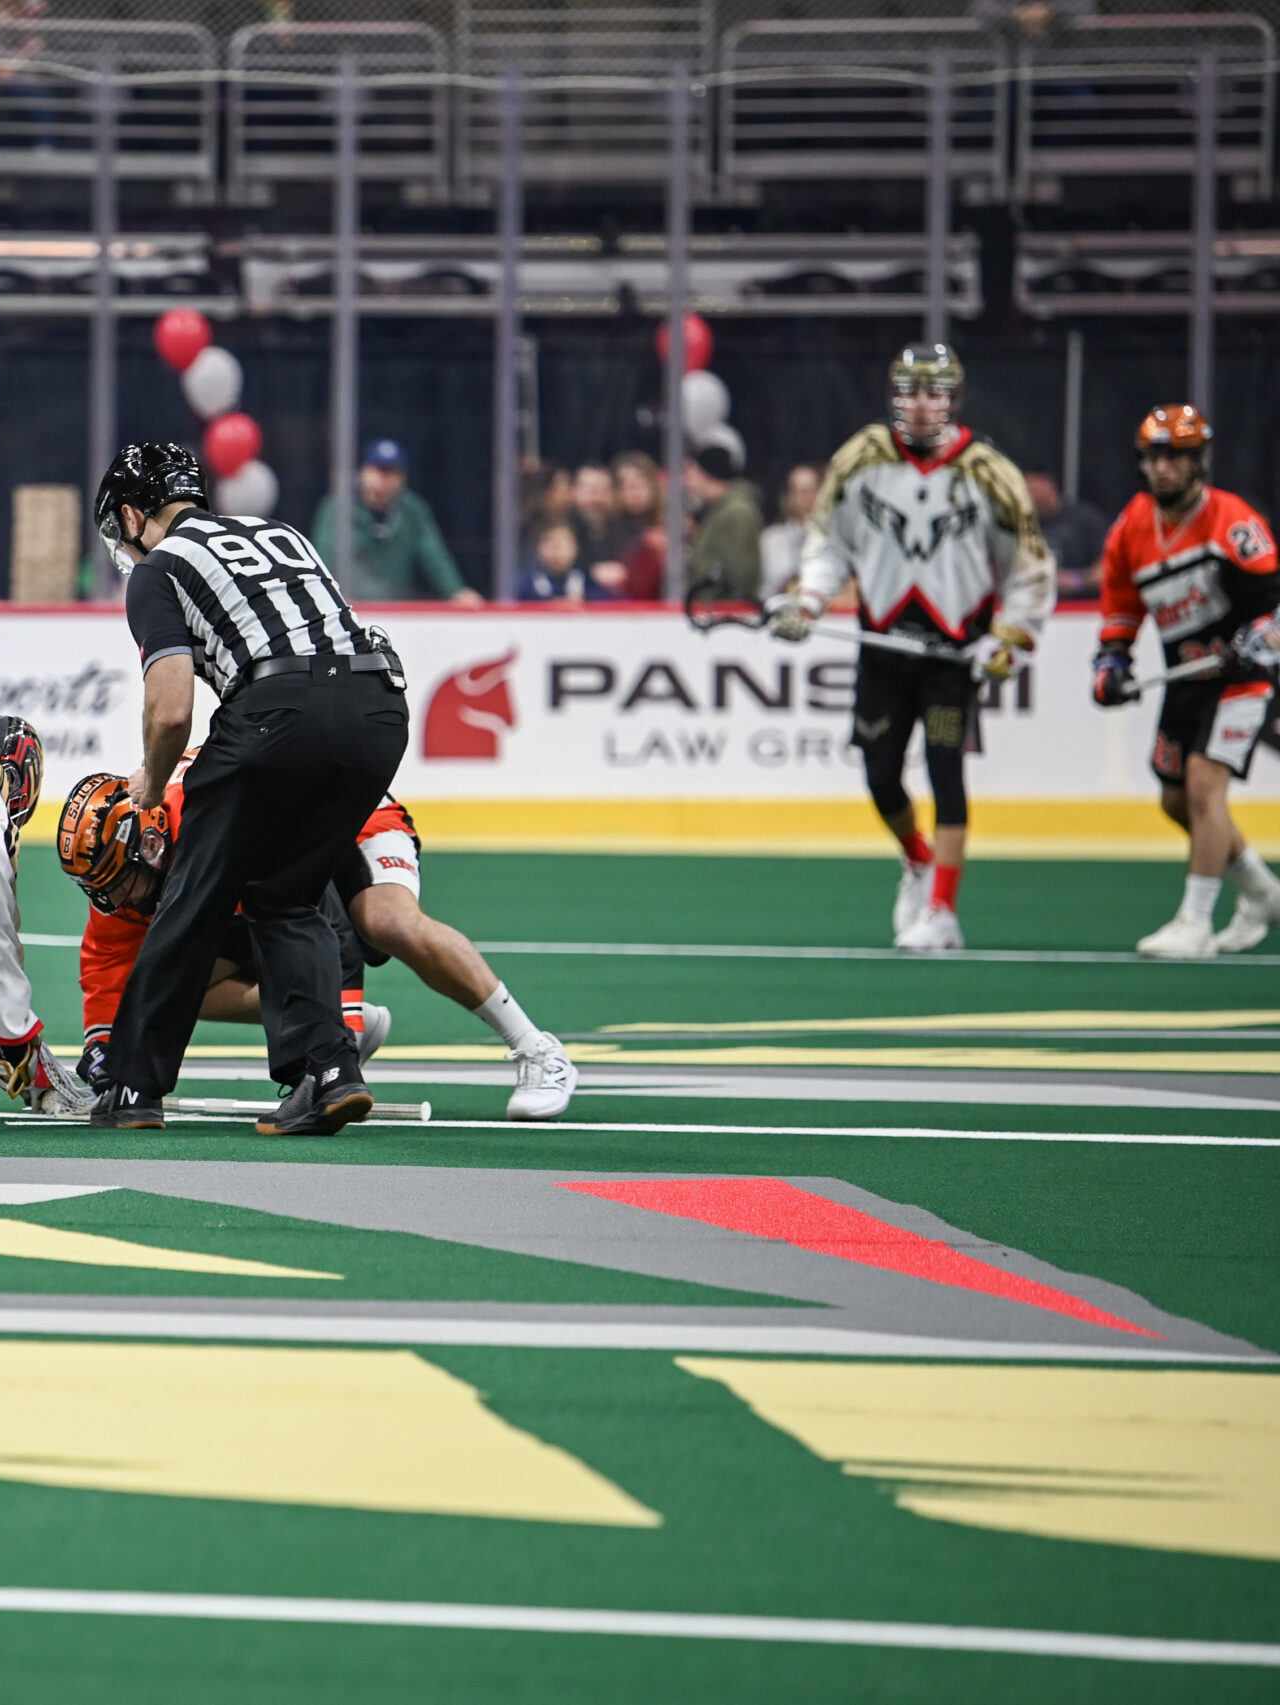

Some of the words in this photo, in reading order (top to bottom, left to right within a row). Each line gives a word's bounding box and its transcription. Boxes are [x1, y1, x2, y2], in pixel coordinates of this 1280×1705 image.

[207, 527, 317, 577] 90
[546, 660, 1035, 712] PANSI
[603, 730, 729, 767] LAW
